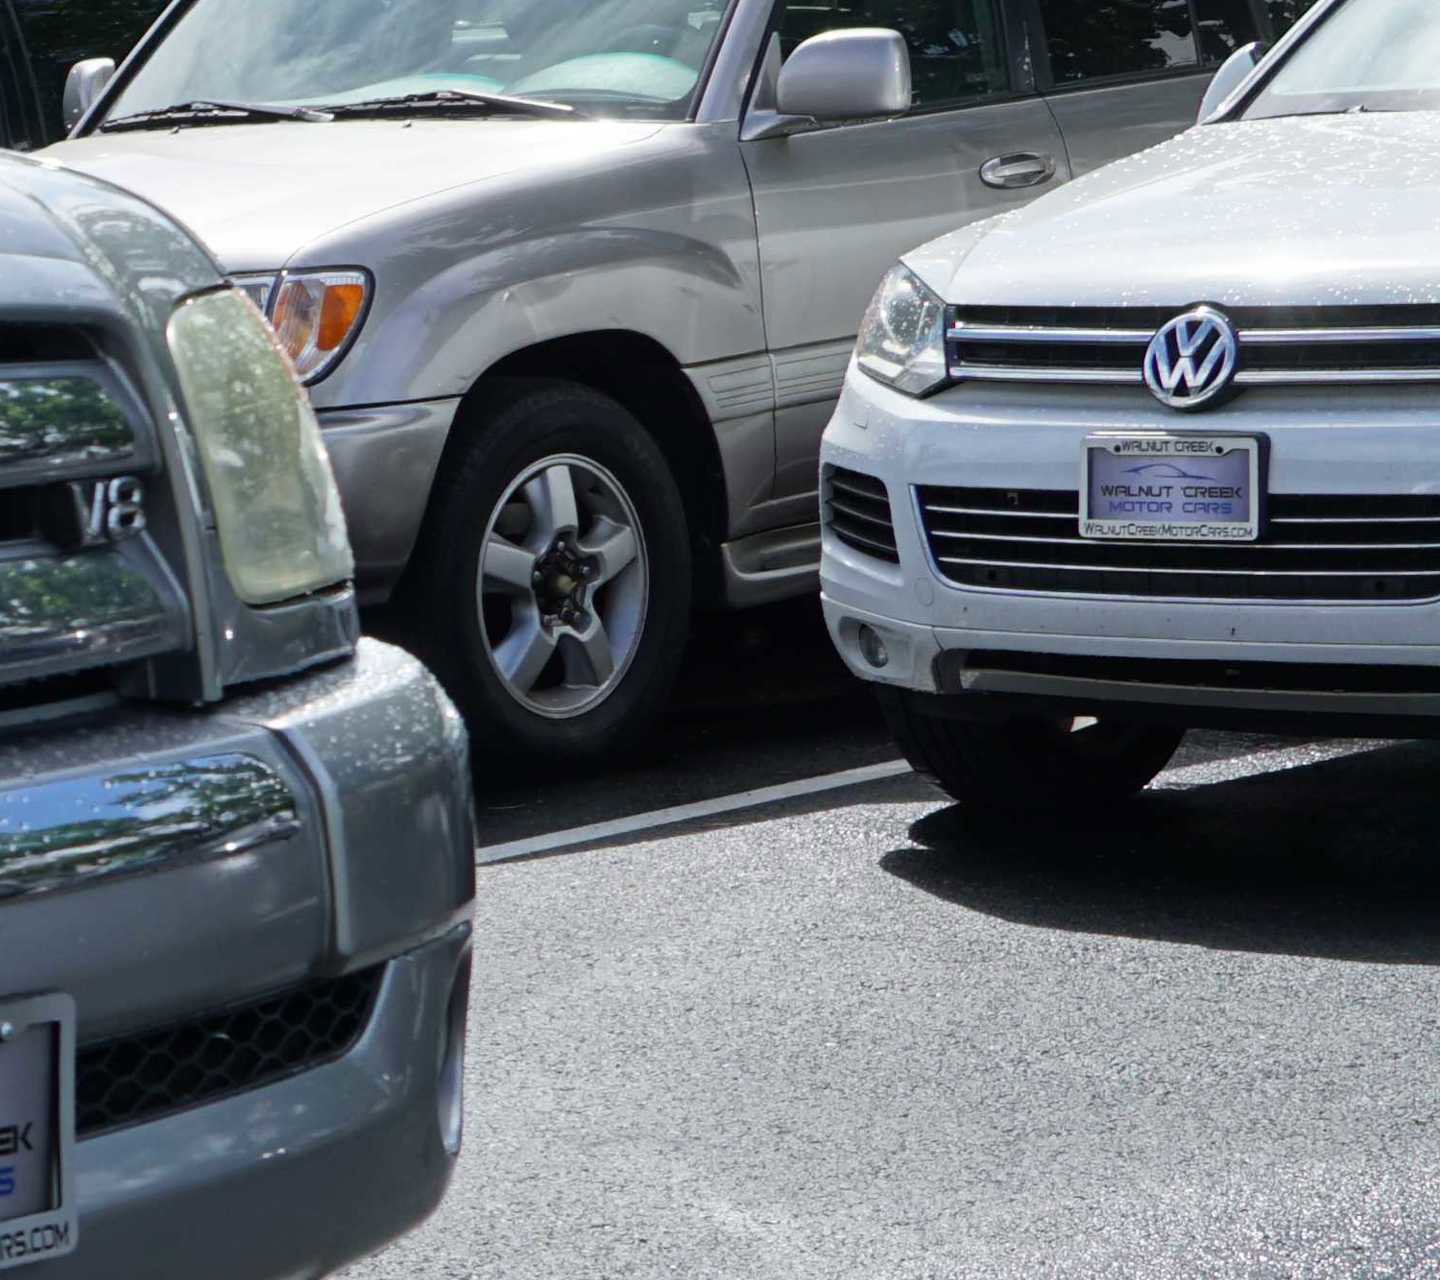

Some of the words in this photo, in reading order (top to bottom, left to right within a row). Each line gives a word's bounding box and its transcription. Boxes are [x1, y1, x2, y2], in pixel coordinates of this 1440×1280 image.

[1121, 440, 1170, 452] WALNUT
[1174, 441, 1214, 453] CREEK
[1100, 485, 1173, 498] WALNUT
[1181, 486, 1242, 498] CREEK
[67, 476, 146, 542] V8
[1108, 501, 1172, 513] MOTOR
[1182, 502, 1232, 514] CARS
